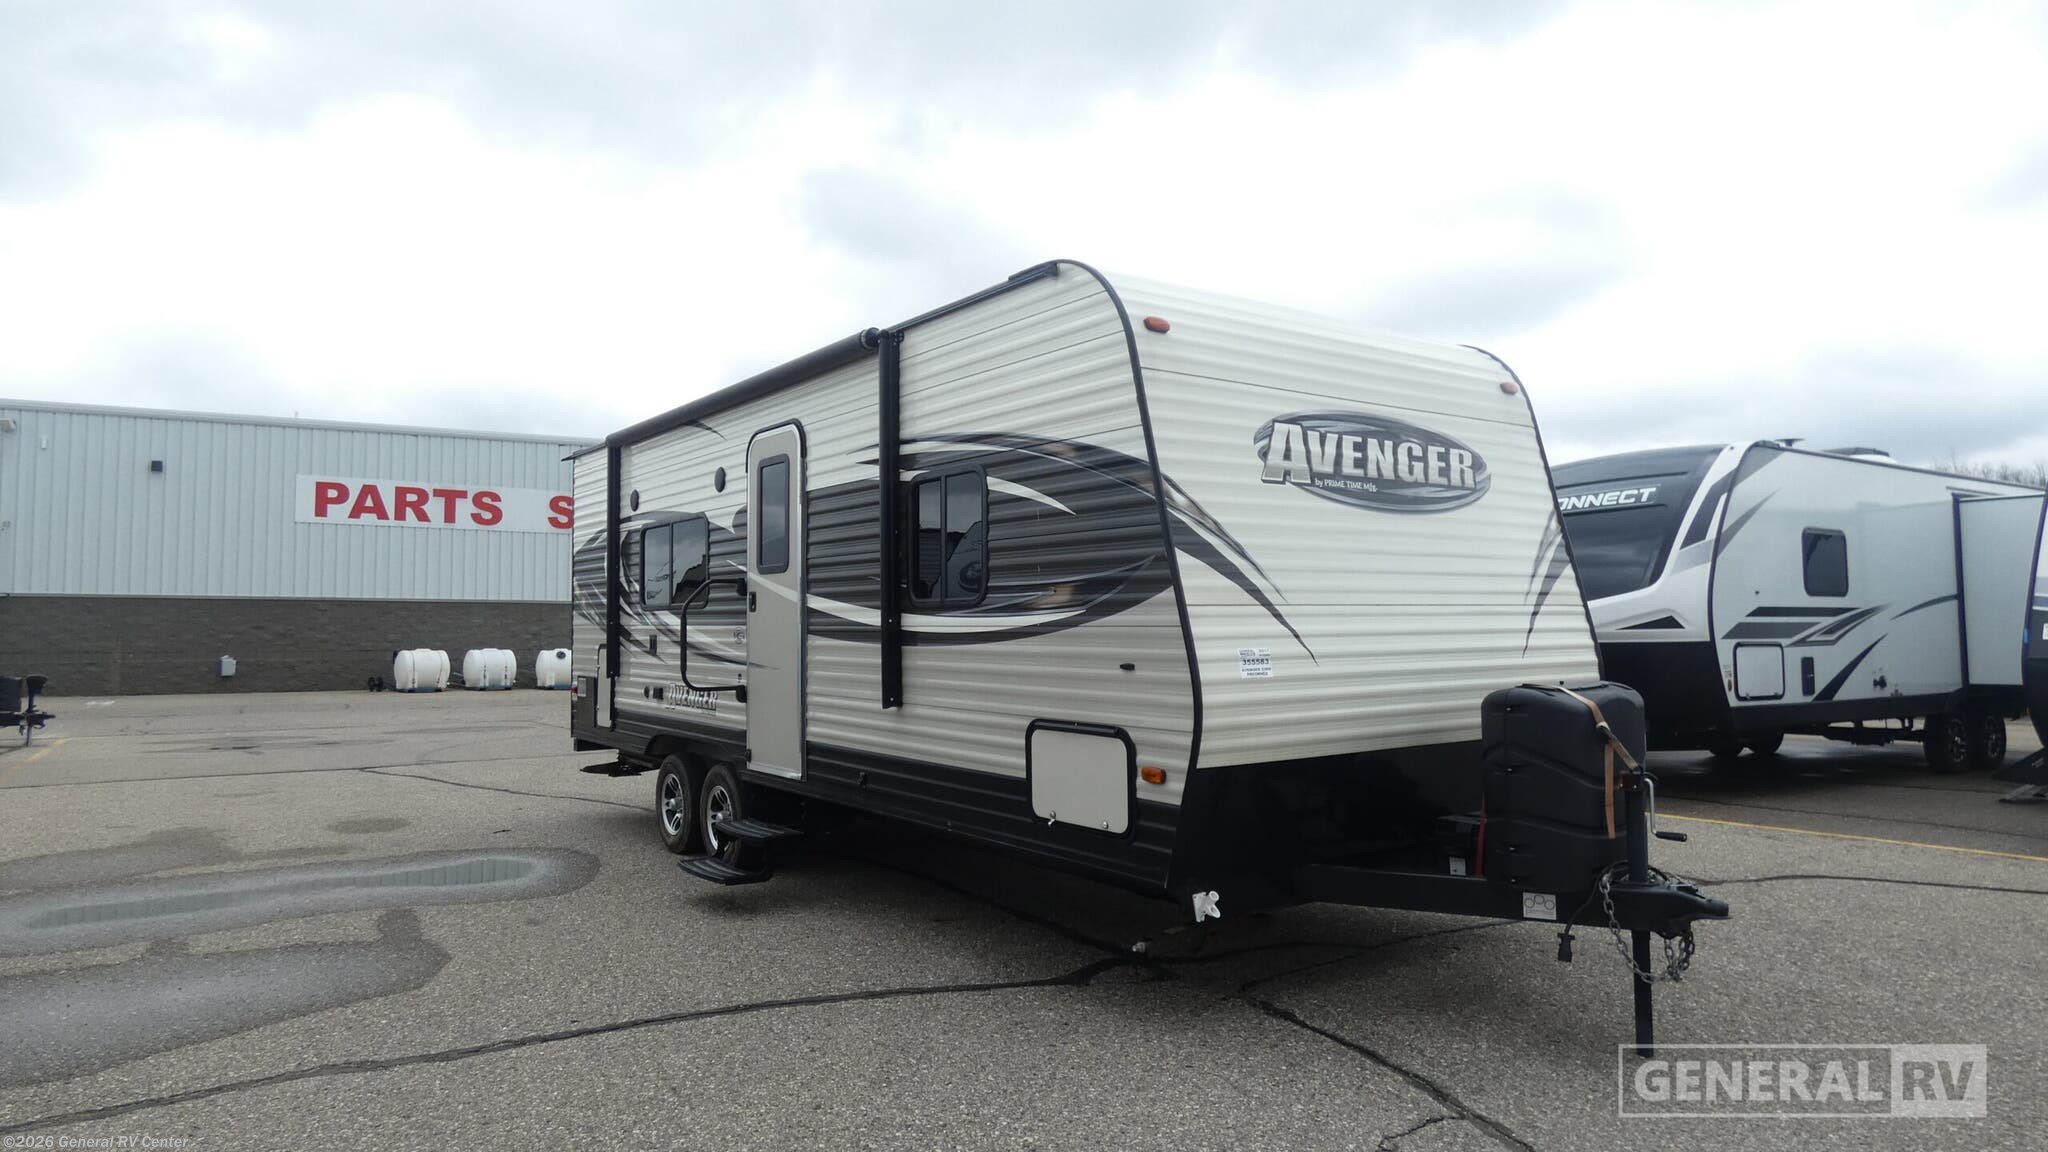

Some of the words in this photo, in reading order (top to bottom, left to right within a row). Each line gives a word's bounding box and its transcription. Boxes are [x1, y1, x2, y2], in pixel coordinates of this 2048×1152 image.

[1262, 421, 1477, 489] AVENGER
[314, 481, 503, 526] PARTS
[1314, 478, 1323, 487] by
[1324, 479, 1345, 488] PRIME
[1346, 480, 1362, 489] TIME
